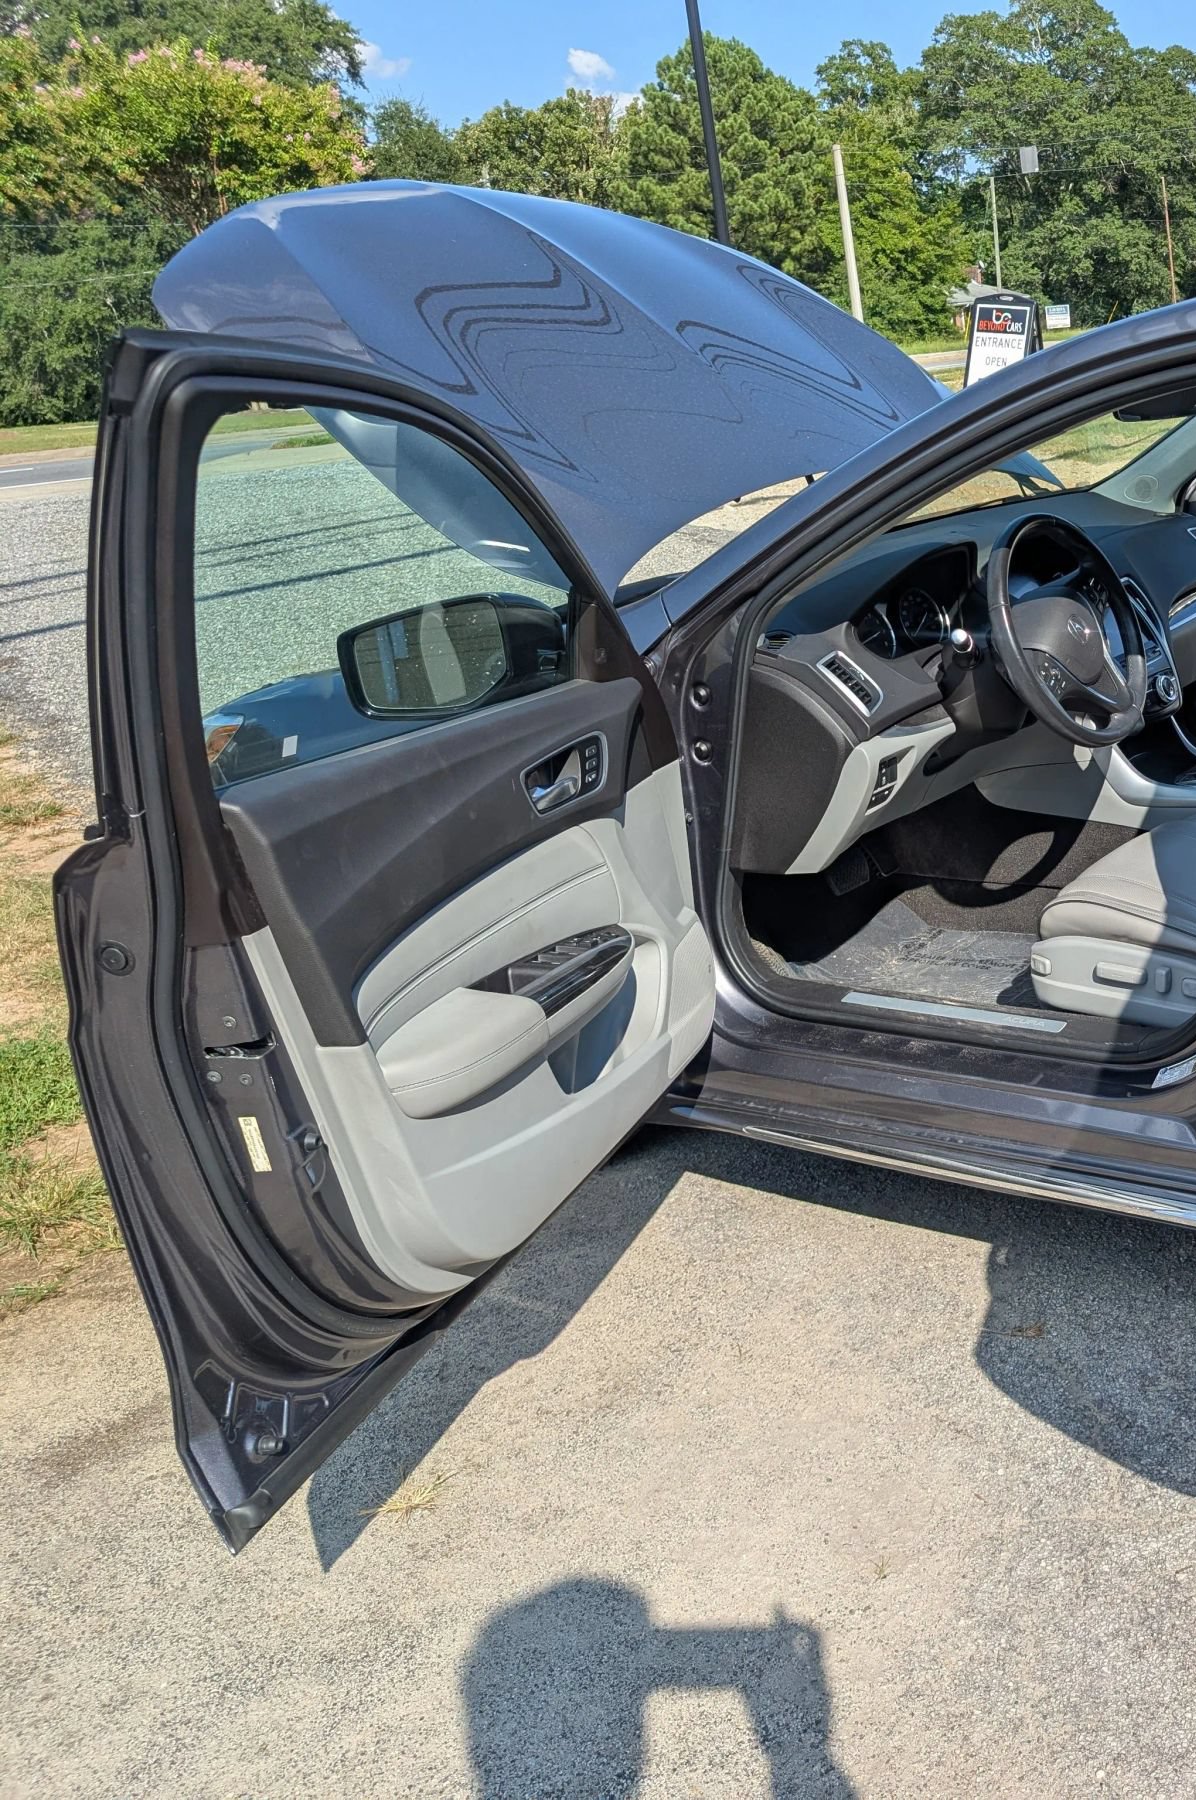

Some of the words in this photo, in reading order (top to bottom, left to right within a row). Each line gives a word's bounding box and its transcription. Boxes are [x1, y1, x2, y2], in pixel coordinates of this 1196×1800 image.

[978, 320, 1005, 332] BEYOND
[1006, 321, 1023, 333] CARS
[975, 336, 1024, 350] ENTRANCE
[985, 356, 1008, 367] OPEN
